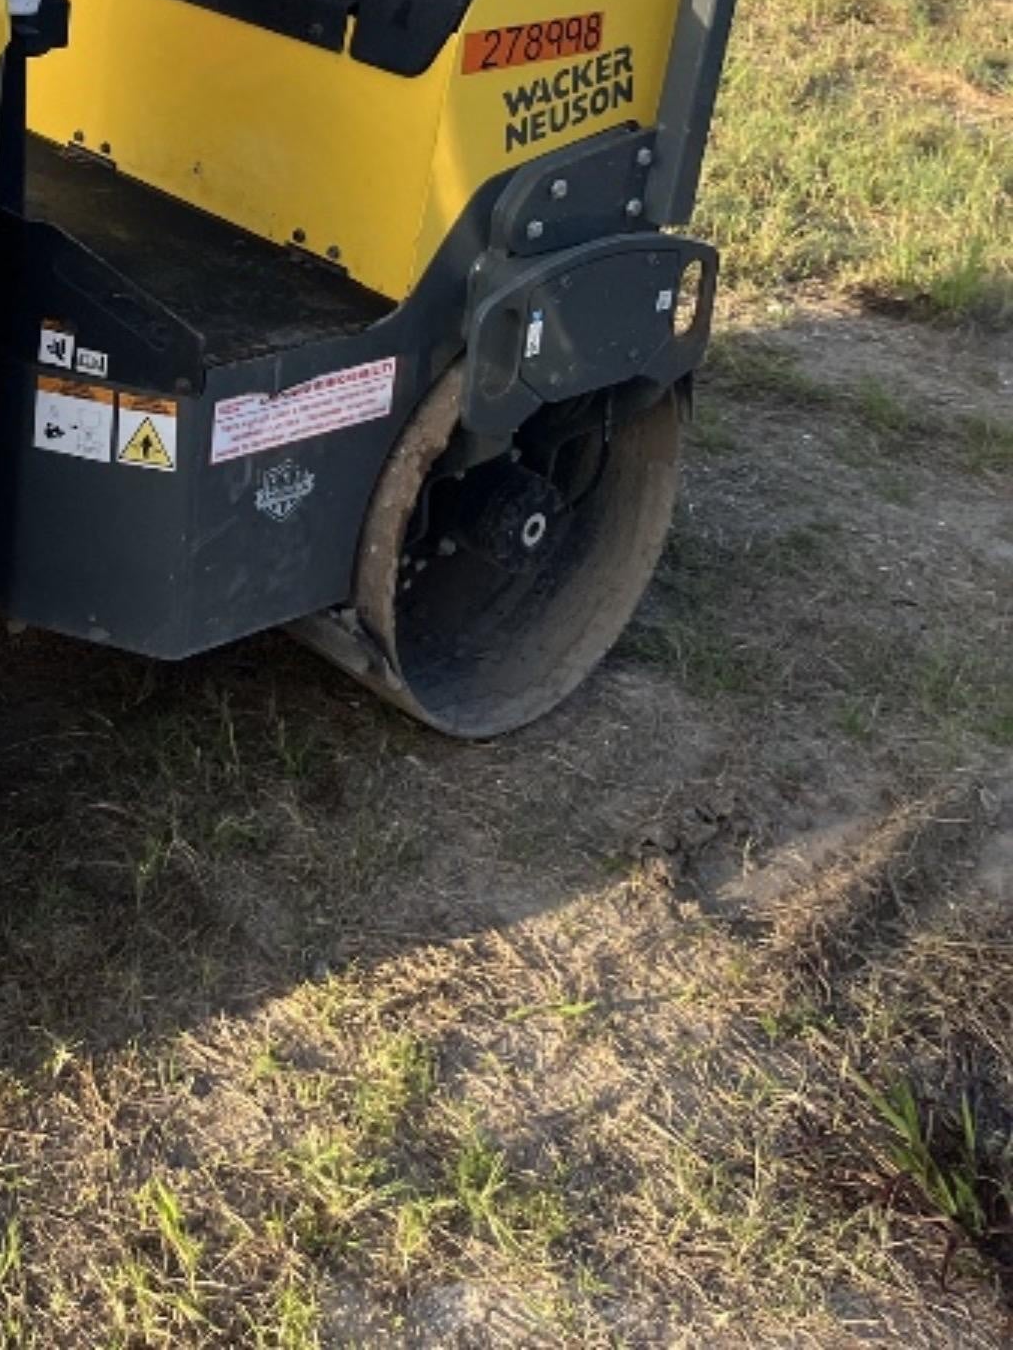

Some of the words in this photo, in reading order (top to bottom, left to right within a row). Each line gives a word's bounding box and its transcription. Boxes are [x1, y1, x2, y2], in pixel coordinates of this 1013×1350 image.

[481, 12, 602, 70] 278998
[502, 45, 634, 117] WACKER
[504, 75, 634, 154] NEUSON
